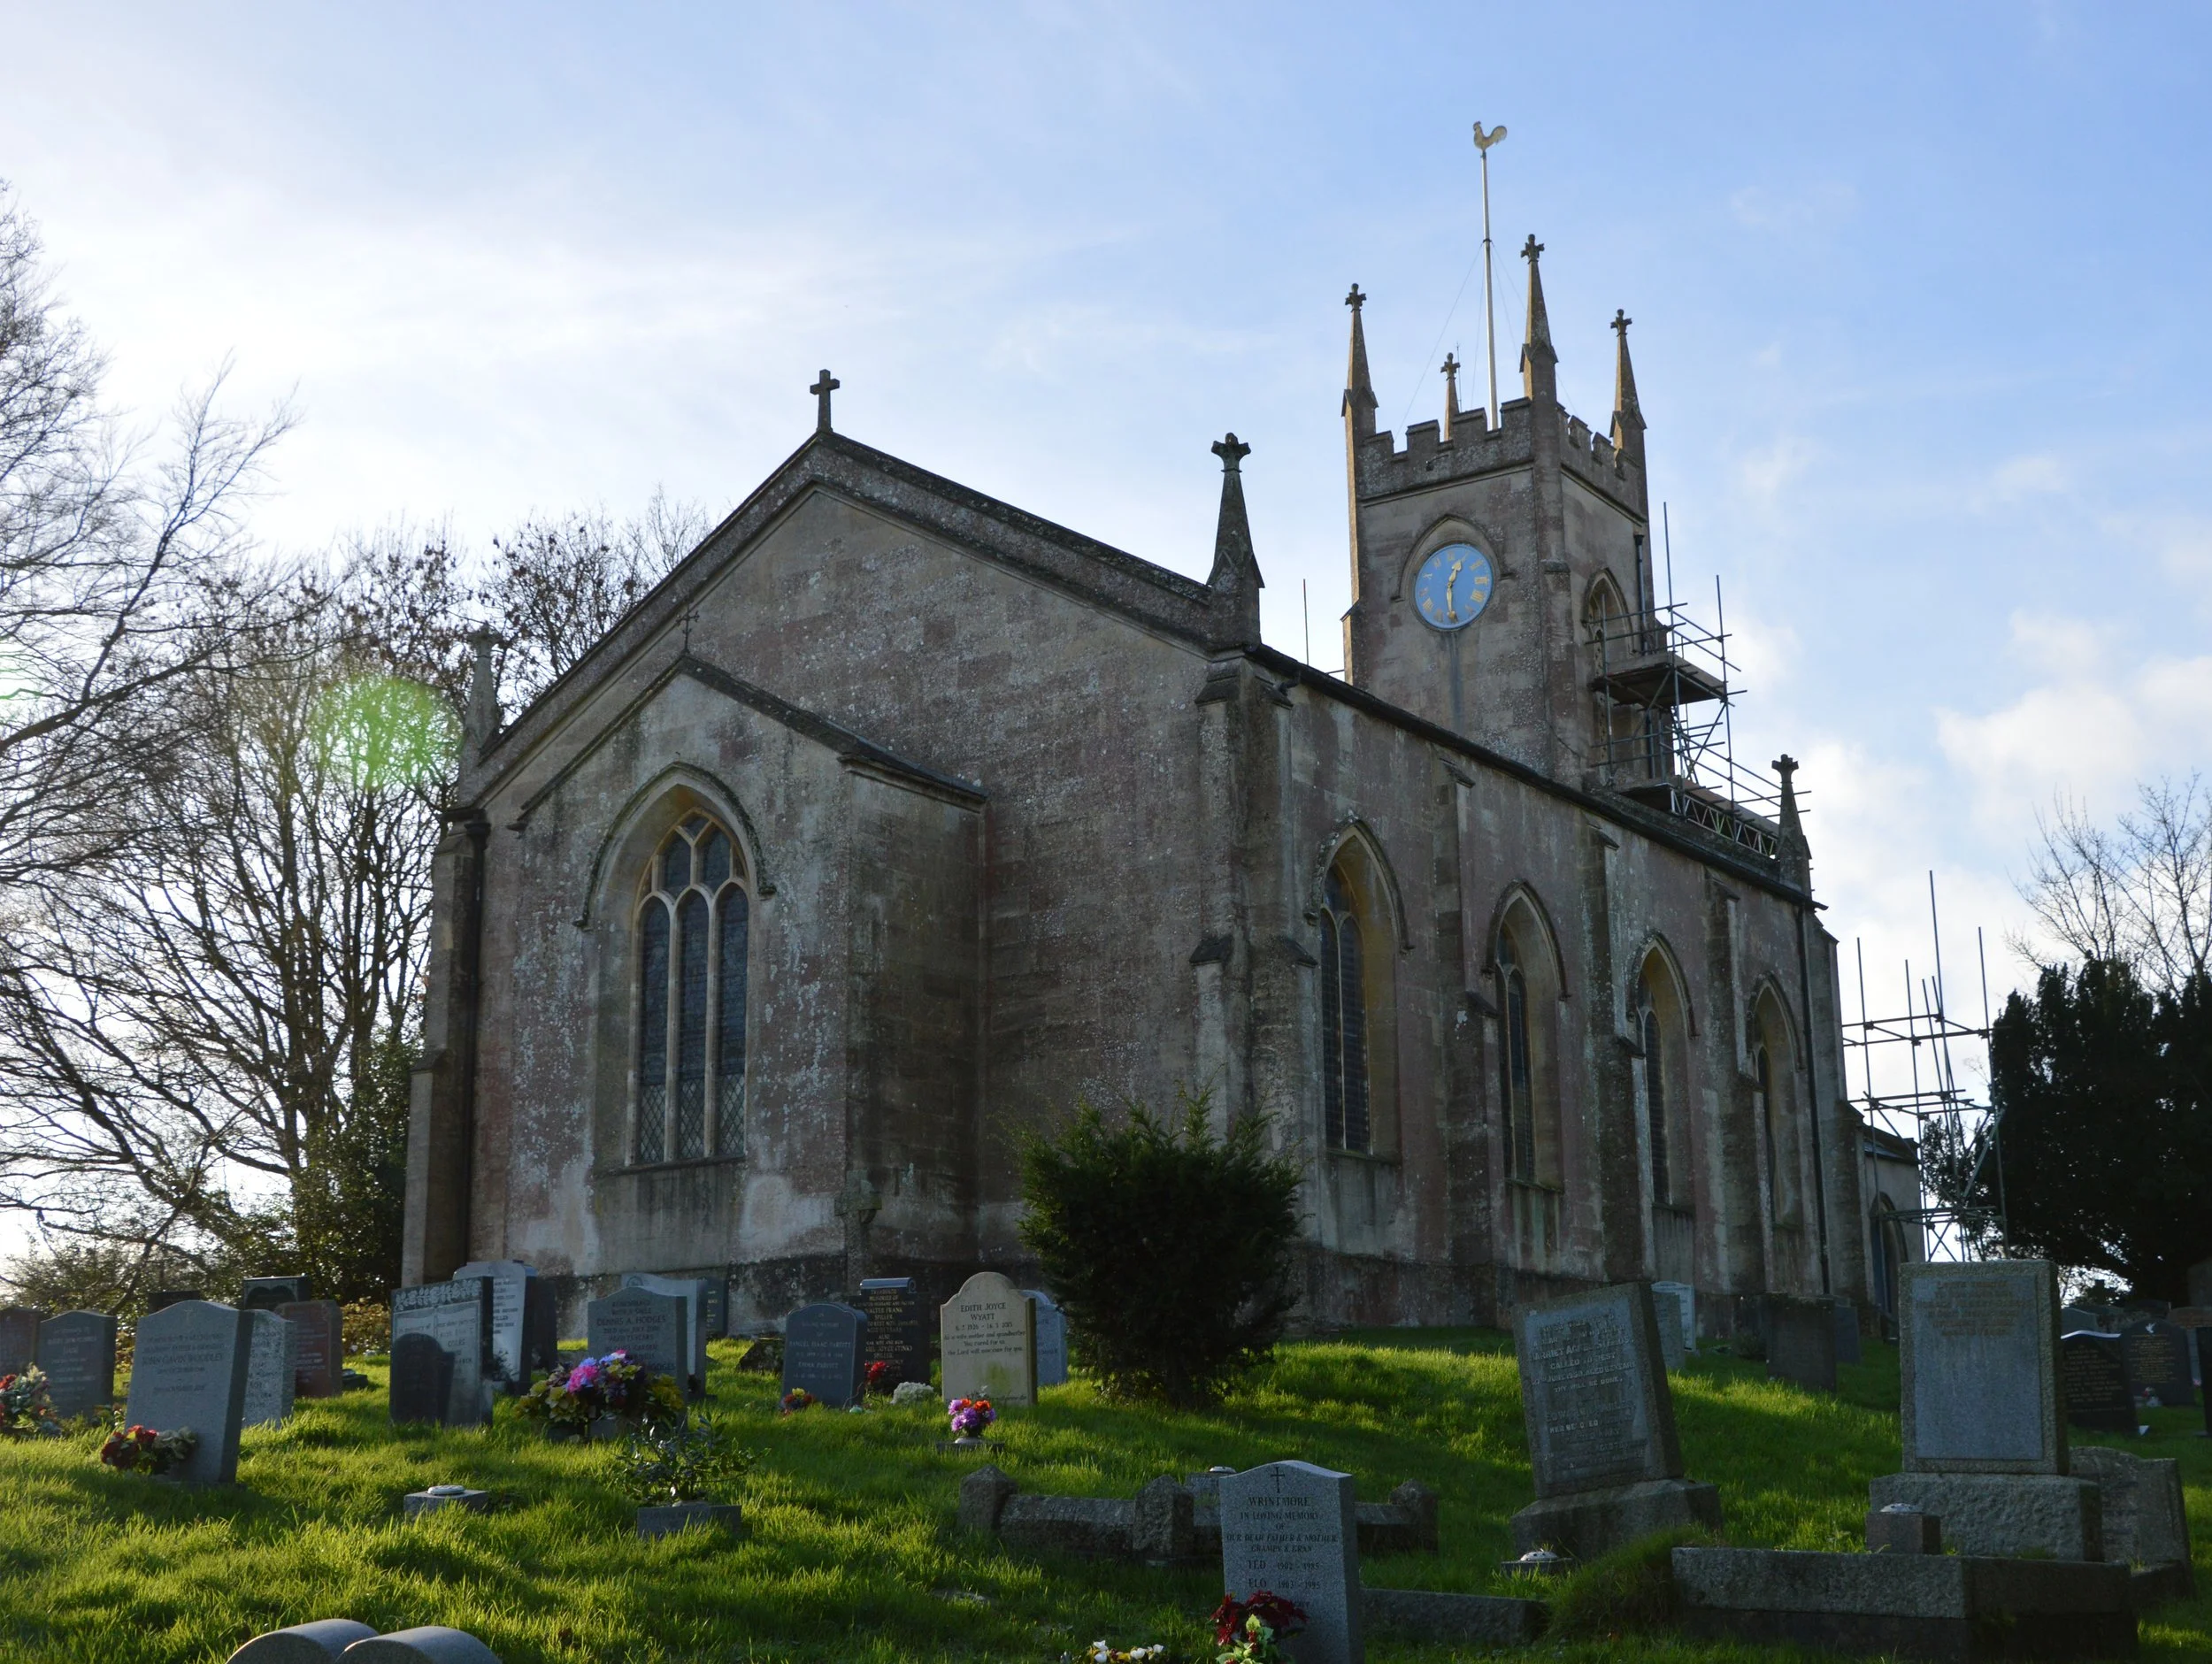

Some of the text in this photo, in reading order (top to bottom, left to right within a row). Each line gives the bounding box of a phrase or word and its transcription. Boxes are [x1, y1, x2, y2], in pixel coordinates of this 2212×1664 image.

[960, 1303, 981, 1312] EDITH
[635, 1315, 666, 1323] HODGES
[1549, 1359, 1580, 1369] CALLED
[1248, 1496, 1310, 1507] WRINTMORE
[1240, 1510, 1318, 1521] IN LOVING MEMORY
[1248, 1560, 1267, 1569] TED
